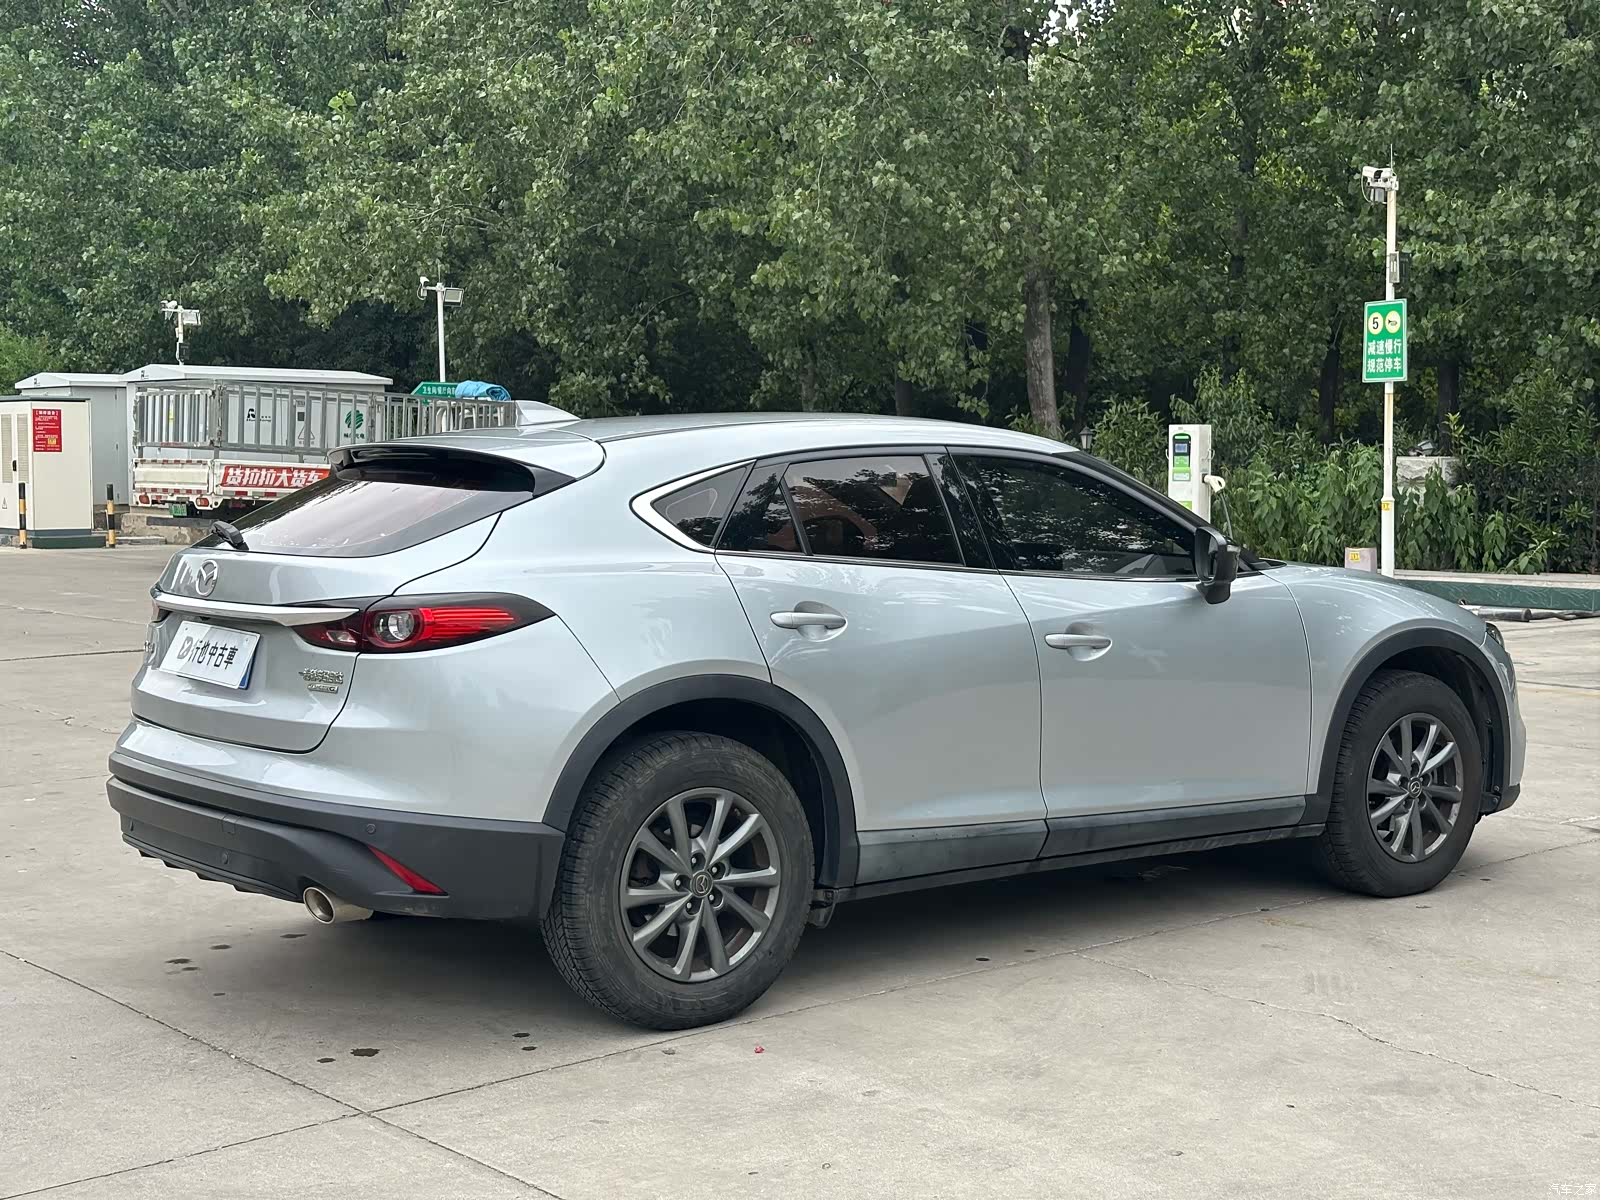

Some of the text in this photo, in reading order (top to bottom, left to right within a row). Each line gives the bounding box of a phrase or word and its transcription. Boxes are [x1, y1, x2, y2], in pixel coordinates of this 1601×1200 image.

[1372, 317, 1380, 330] 5
[1367, 338, 1402, 355] 减速慢行
[1366, 356, 1402, 373] 规范停车
[225, 467, 322, 487] 货拉拉大货车
